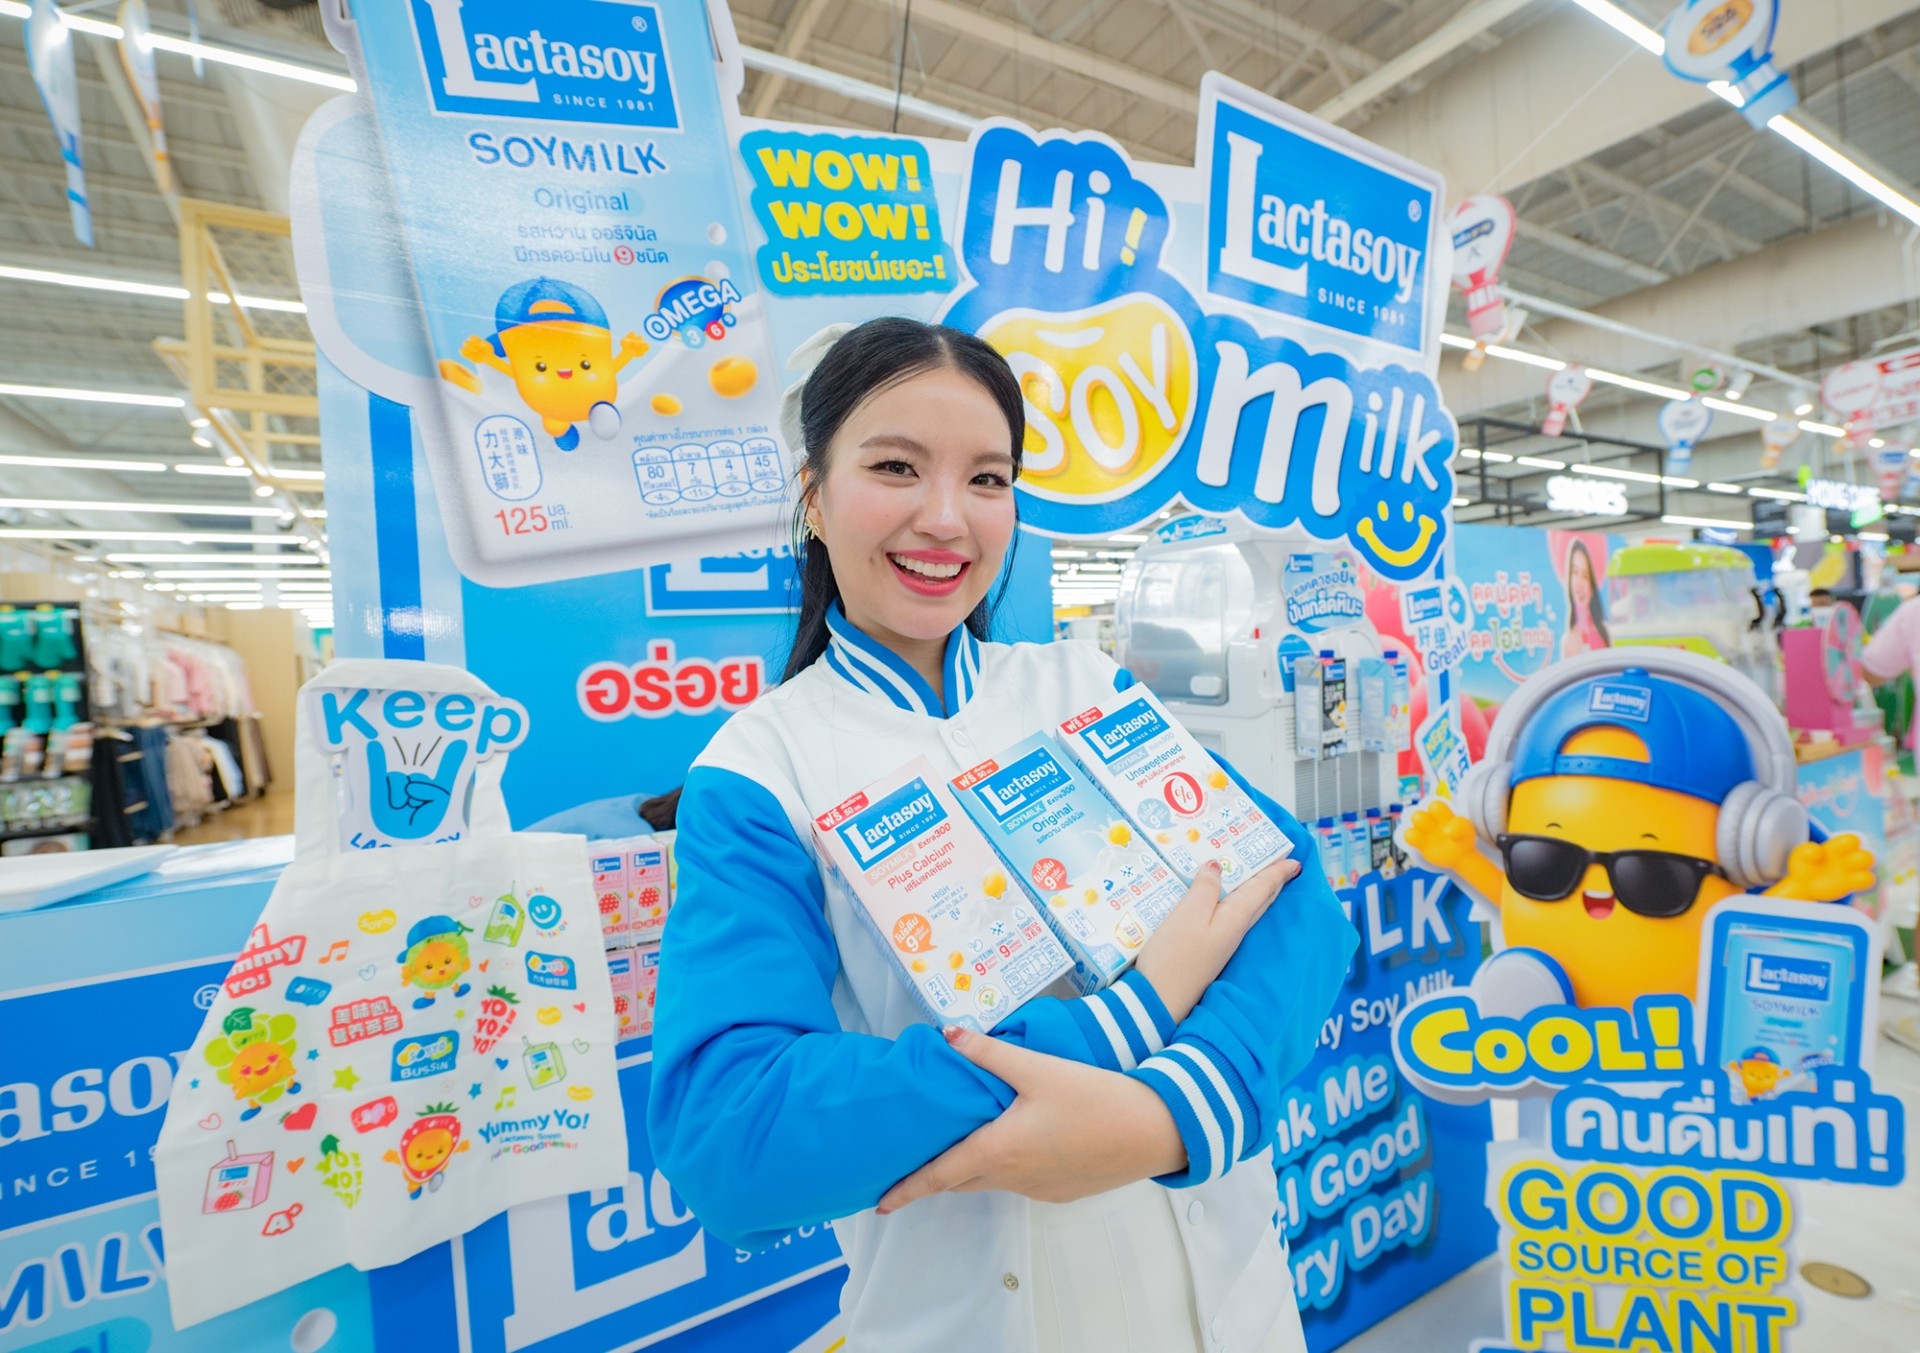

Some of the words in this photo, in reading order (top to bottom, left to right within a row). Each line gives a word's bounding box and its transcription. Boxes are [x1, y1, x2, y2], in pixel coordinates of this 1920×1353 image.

[425, 0, 657, 103] Lactasoy
[553, 92, 608, 109] SINCE
[616, 99, 655, 112] 1981
[469, 133, 667, 175] SOYMILK
[757, 147, 922, 191] WOW!
[534, 187, 629, 216] Original
[990, 158, 1147, 274] Hi!
[1219, 131, 1421, 303] Lactasoy
[518, 224, 587, 241] รสหวาน
[591, 222, 658, 242] ออริจินัล
[769, 200, 930, 240] WOW!
[515, 245, 611, 263] มีกรดอะมิโน
[635, 245, 669, 264] ชนิด
[771, 249, 946, 283] ประโยชน์เยอะ!
[646, 280, 740, 339] OMEGA
[1318, 288, 1366, 315] SINCE
[1373, 304, 1406, 326] 1981
[688, 329, 701, 345] 3
[711, 323, 722, 338] 6
[1006, 322, 1178, 474] SOY
[647, 465, 664, 478] 80
[688, 462, 695, 474] 7
[725, 459, 733, 470] 4
[754, 456, 770, 467] 45
[495, 505, 548, 536] 125
[551, 516, 573, 530] ml.
[1428, 630, 1467, 671] Great!
[584, 646, 759, 715] อร่อย
[321, 688, 522, 755] Keep
[1085, 709, 1157, 759] Lactasoy
[1125, 744, 1182, 781] Unsweetened
[979, 760, 1058, 816] Lactasoy
[1047, 784, 1075, 805] Extra300
[843, 792, 934, 863] Lactasoy
[899, 824, 919, 839] SINCE
[1007, 805, 1043, 830] SOYMILK
[1032, 803, 1074, 833] Original
[1150, 814, 1160, 827] 9
[1229, 825, 1239, 836] 9
[918, 823, 951, 850] Extra300
[1210, 838, 1221, 848] 9
[887, 869, 913, 889] Plus
[912, 841, 955, 871] Calcium
[931, 885, 950, 901] HIGH
[1044, 876, 1057, 889] 9
[1131, 885, 1142, 895] 9
[1110, 900, 1121, 910] 9
[906, 935, 919, 952] 9
[999, 945, 1011, 957] 9
[229, 973, 265, 994] YO!
[975, 962, 986, 976] 9
[1748, 957, 1827, 991] Lactasoy
[1351, 993, 1398, 1032] Soy
[1405, 969, 1454, 1004] Milk
[1752, 999, 1820, 1017] SOYMILK
[1323, 1064, 1388, 1126] Me
[478, 1114, 549, 1143] Yummy
[553, 1109, 590, 1129] Yo!
[1565, 1079, 1888, 1172] คนดื่มเท่!
[1311, 1104, 1420, 1207] Good
[1508, 1167, 1782, 1242] GOOD
[1292, 1239, 1339, 1298] ry
[1351, 1181, 1428, 1259] Day
[1519, 1240, 1702, 1282] SOURCE
[1717, 1253, 1778, 1285] OF
[1519, 1288, 1786, 1353] PLANT
